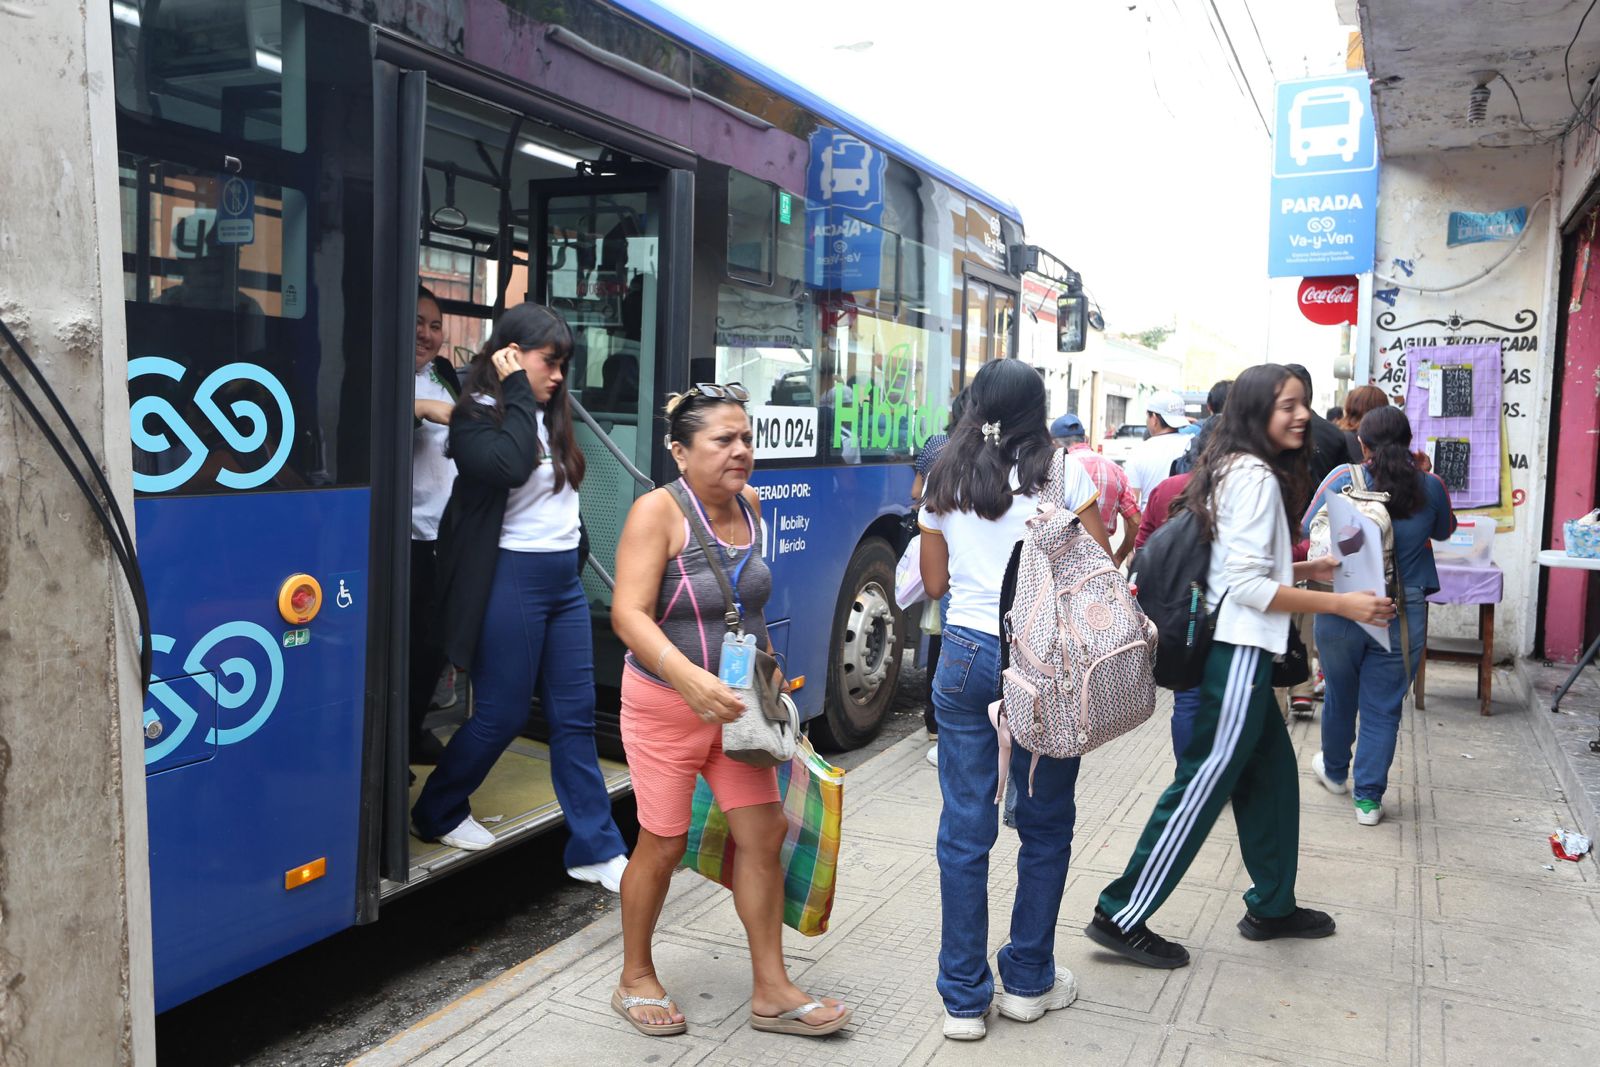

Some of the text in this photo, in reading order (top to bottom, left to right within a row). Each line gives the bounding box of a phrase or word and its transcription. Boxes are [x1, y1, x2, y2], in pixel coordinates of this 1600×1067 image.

[1281, 194, 1363, 214] PARADA
[1289, 232, 1354, 249] Va-y-Ven
[1301, 285, 1356, 304] Coca-Cola
[756, 418, 814, 449] MO 024
[753, 483, 811, 500] PERADO POR:
[780, 515, 810, 532] Mobility
